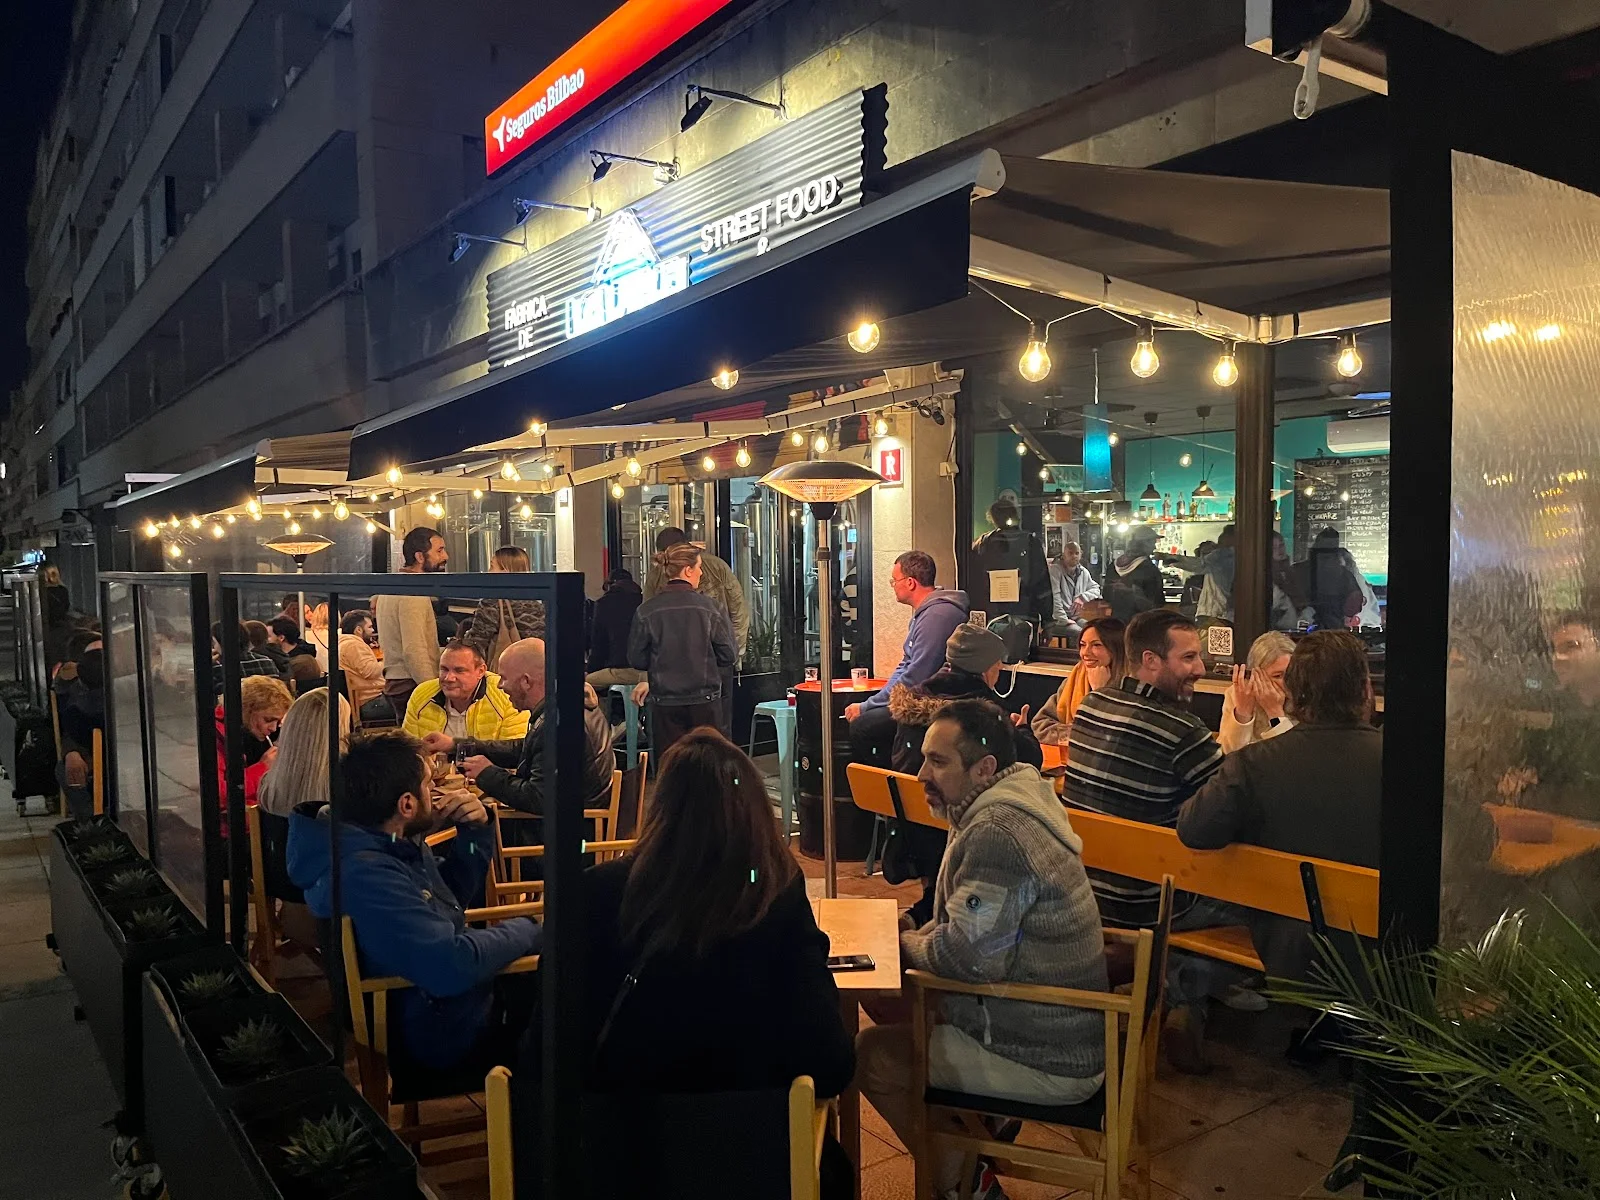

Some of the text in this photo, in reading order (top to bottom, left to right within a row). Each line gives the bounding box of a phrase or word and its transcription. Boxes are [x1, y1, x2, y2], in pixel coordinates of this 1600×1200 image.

[506, 68, 585, 142] Seguros Bilbao
[700, 174, 837, 252] STREET FOOD
[504, 295, 548, 331] FÁBRICA
[518, 326, 534, 351] DE
